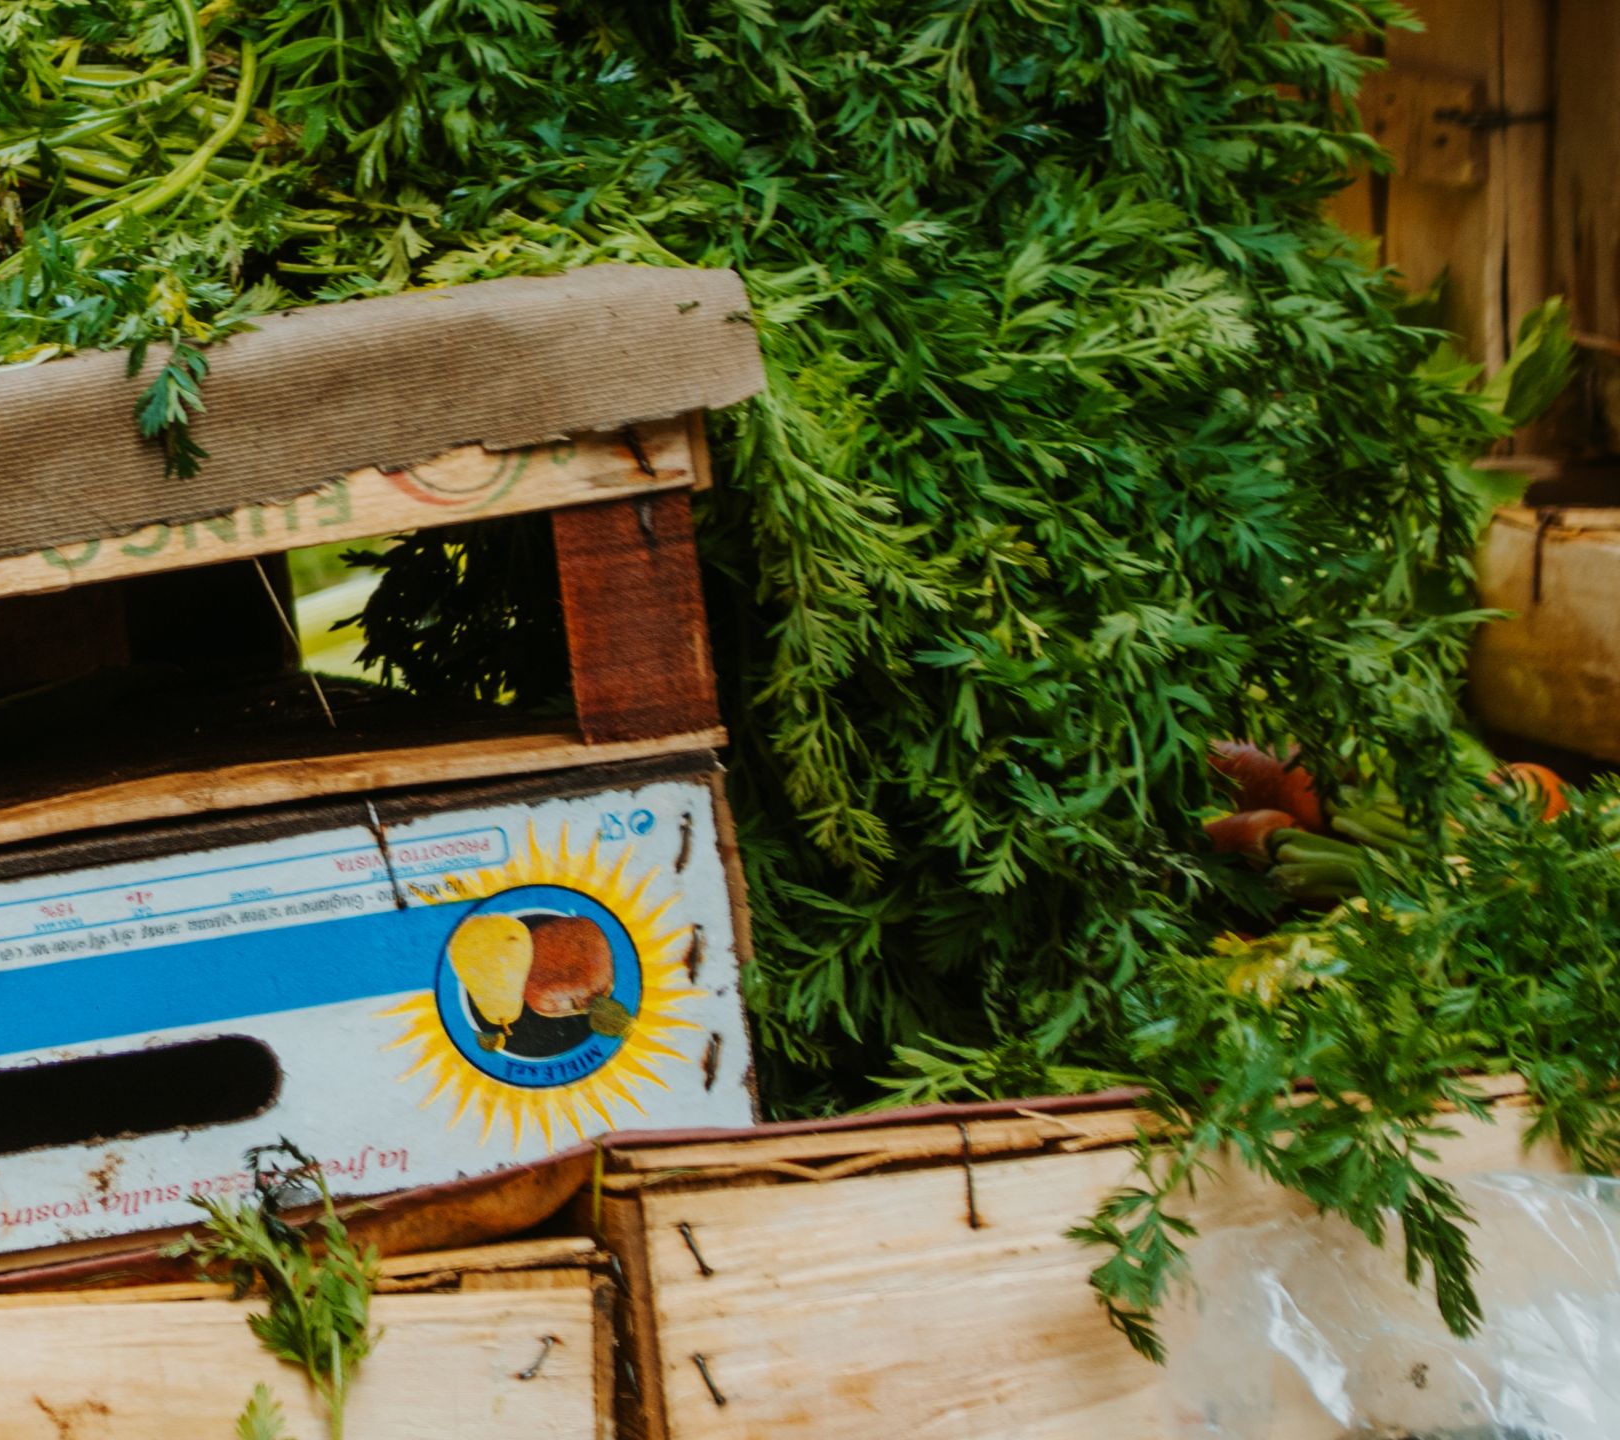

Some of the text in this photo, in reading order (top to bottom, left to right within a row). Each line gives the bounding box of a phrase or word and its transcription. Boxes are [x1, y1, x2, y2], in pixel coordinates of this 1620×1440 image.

[400, 837, 491, 863] PRODOTTO
[39, 902, 74, 919] 15%
[542, 1044, 603, 1081] MIELE
[378, 1147, 410, 1173] la
[105, 1182, 181, 1217] sulla
